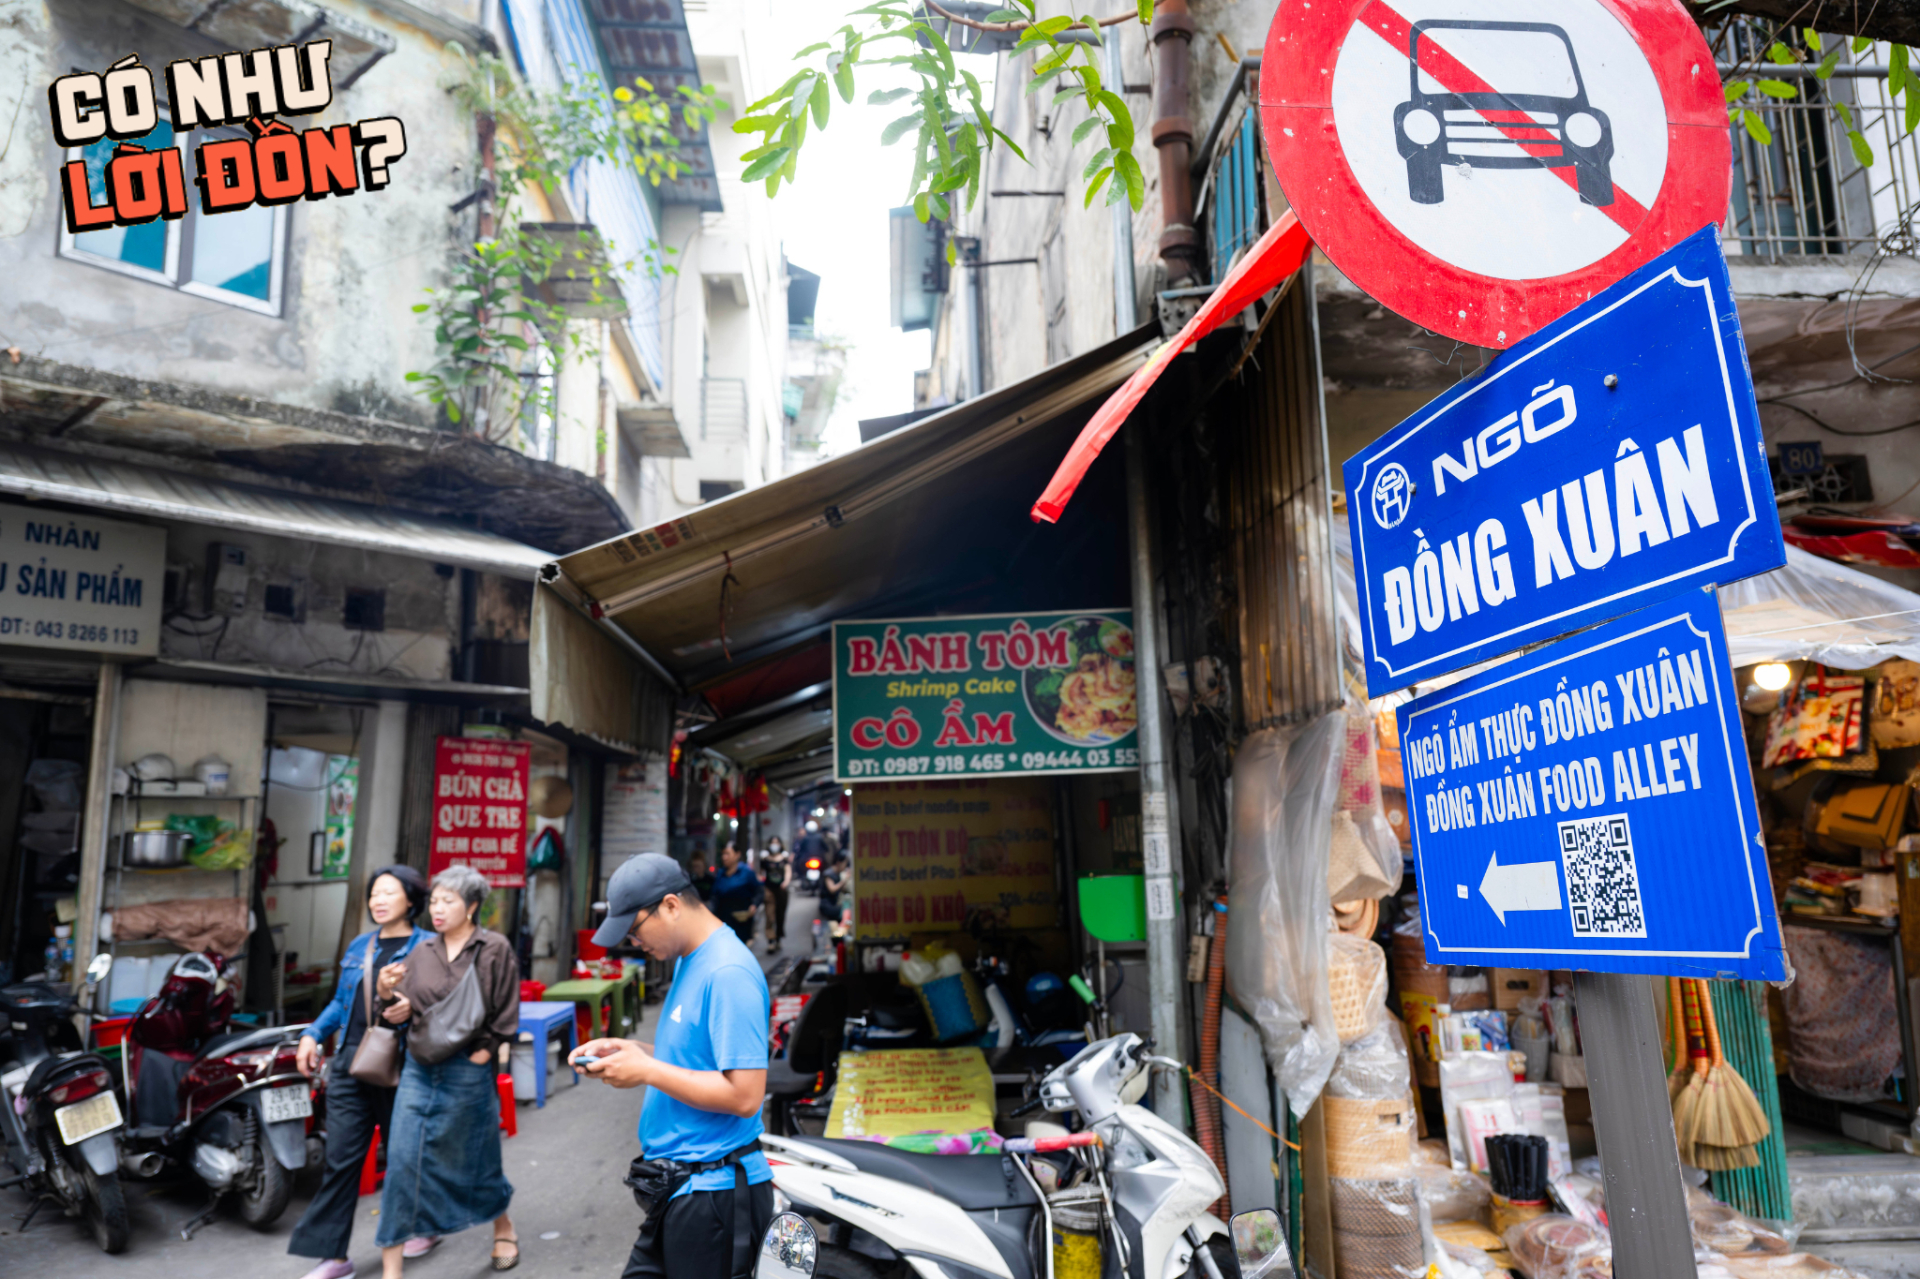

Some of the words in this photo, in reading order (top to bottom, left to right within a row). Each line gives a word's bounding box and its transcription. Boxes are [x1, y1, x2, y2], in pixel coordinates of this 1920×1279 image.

[1432, 379, 1577, 496] NGÕ
[1789, 448, 1815, 470] 80
[1383, 527, 1517, 646] ĐỒNG
[1521, 423, 1720, 588] XUÂN
[16, 557, 67, 600] SẢN
[76, 563, 143, 608] PHẨM
[34, 620, 64, 639] 043
[68, 623, 109, 643] 8266
[112, 628, 139, 646] 113
[848, 625, 972, 676] BÁNH
[976, 620, 1072, 671] TÔM
[886, 679, 960, 699] Shrimp
[965, 678, 1017, 696] Cake
[851, 706, 921, 750] CÔ
[1410, 723, 1446, 780] NGÕ
[1448, 709, 1480, 770] ẨM
[1480, 702, 1537, 764] THỰC
[1539, 676, 1614, 746] ĐỒNG
[1615, 646, 1709, 725] XUÂN
[848, 758, 880, 776] ĐT:
[883, 756, 930, 775] 0987
[933, 755, 966, 773] 918
[969, 753, 1005, 771] 465
[1021, 751, 1083, 770] 09444
[1087, 749, 1110, 766] 03
[438, 769, 483, 798] BÚN
[485, 770, 525, 801] CHẢ
[1425, 778, 1476, 834] ĐỒNG
[1476, 765, 1537, 825] XUÂN
[1539, 756, 1606, 815] FOOD
[1612, 733, 1702, 803] ALLEY
[438, 804, 482, 832] QUE
[485, 806, 522, 829] TRE
[436, 836, 470, 853] NEM
[471, 838, 499, 854] CUA
[857, 824, 891, 858] PHỞ
[896, 824, 941, 862] TRỘN
[859, 866, 897, 881] Mixed
[900, 865, 928, 881] beef
[859, 893, 898, 929] NỘM
